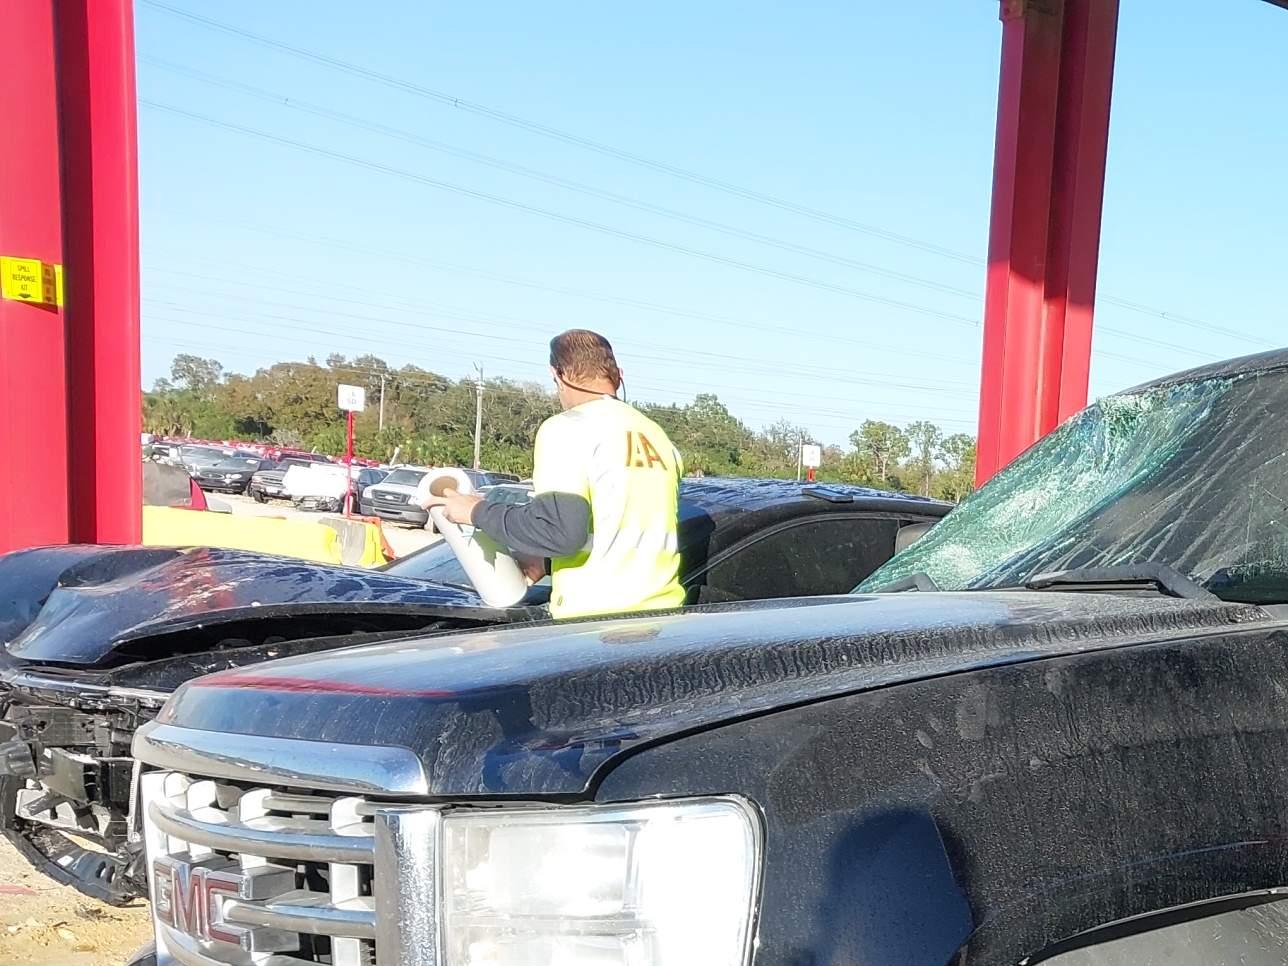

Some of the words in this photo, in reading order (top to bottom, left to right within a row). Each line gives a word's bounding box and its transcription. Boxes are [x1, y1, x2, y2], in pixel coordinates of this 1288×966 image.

[12, 274, 36, 283] RESPONSE
[20, 284, 28, 292] KIT
[153, 857, 253, 953] GMC
